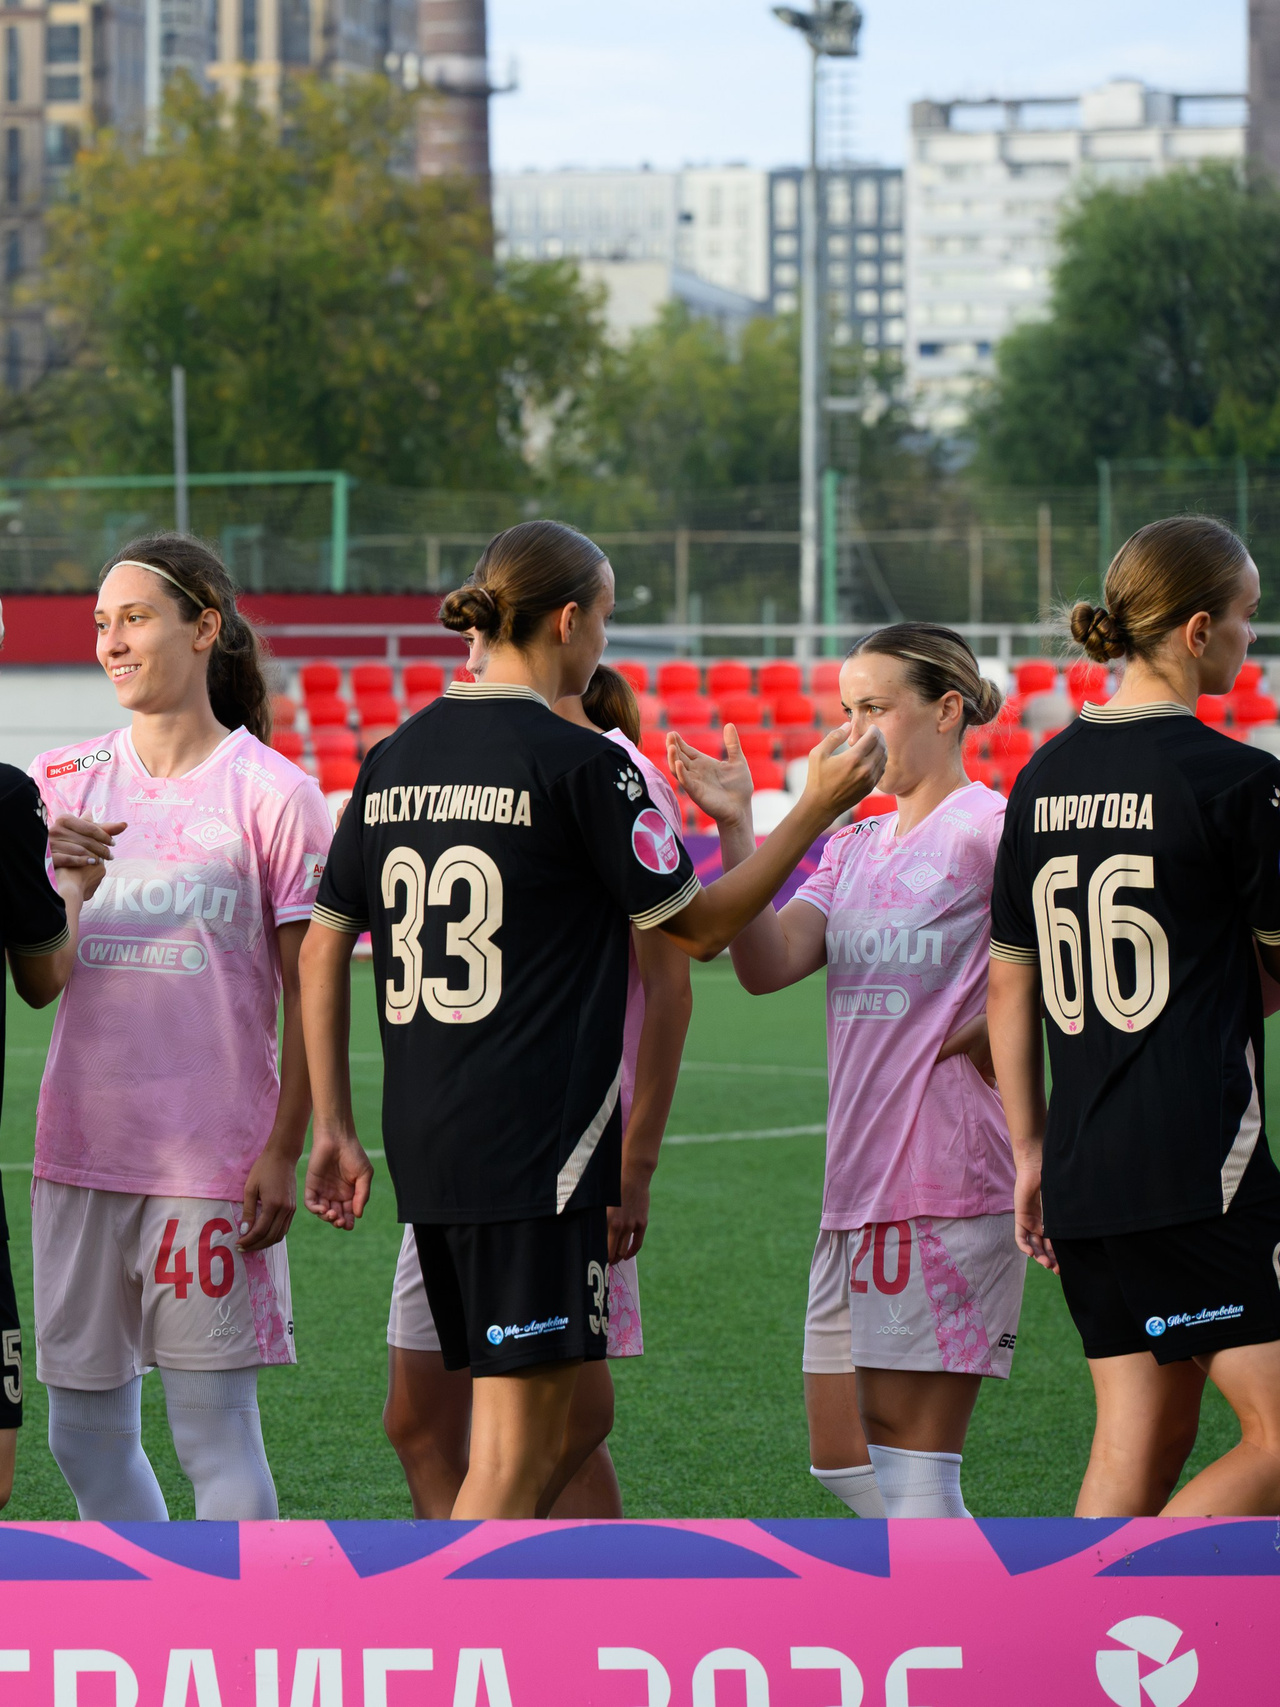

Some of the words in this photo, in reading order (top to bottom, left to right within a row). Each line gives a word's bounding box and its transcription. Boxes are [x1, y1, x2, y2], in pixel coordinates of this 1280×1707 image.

[230, 762, 284, 801] ПРОТЕКТ
[235, 756, 276, 781] КИБЕР
[363, 785, 532, 827] ФАСХУТДИНОВА
[940, 814, 982, 838] ПРОТЕКТ
[946, 807, 974, 820] КИБЕР
[1033, 793, 1154, 833] ПИРОГОВА
[91, 873, 238, 923] УКОЙЛ
[89, 942, 180, 966] WINLINE
[381, 845, 504, 1025] 33
[826, 920, 943, 965] УКОЙЛ
[1032, 854, 1170, 1036] 66
[154, 1217, 235, 1299] 46
[850, 1220, 912, 1295] 20
